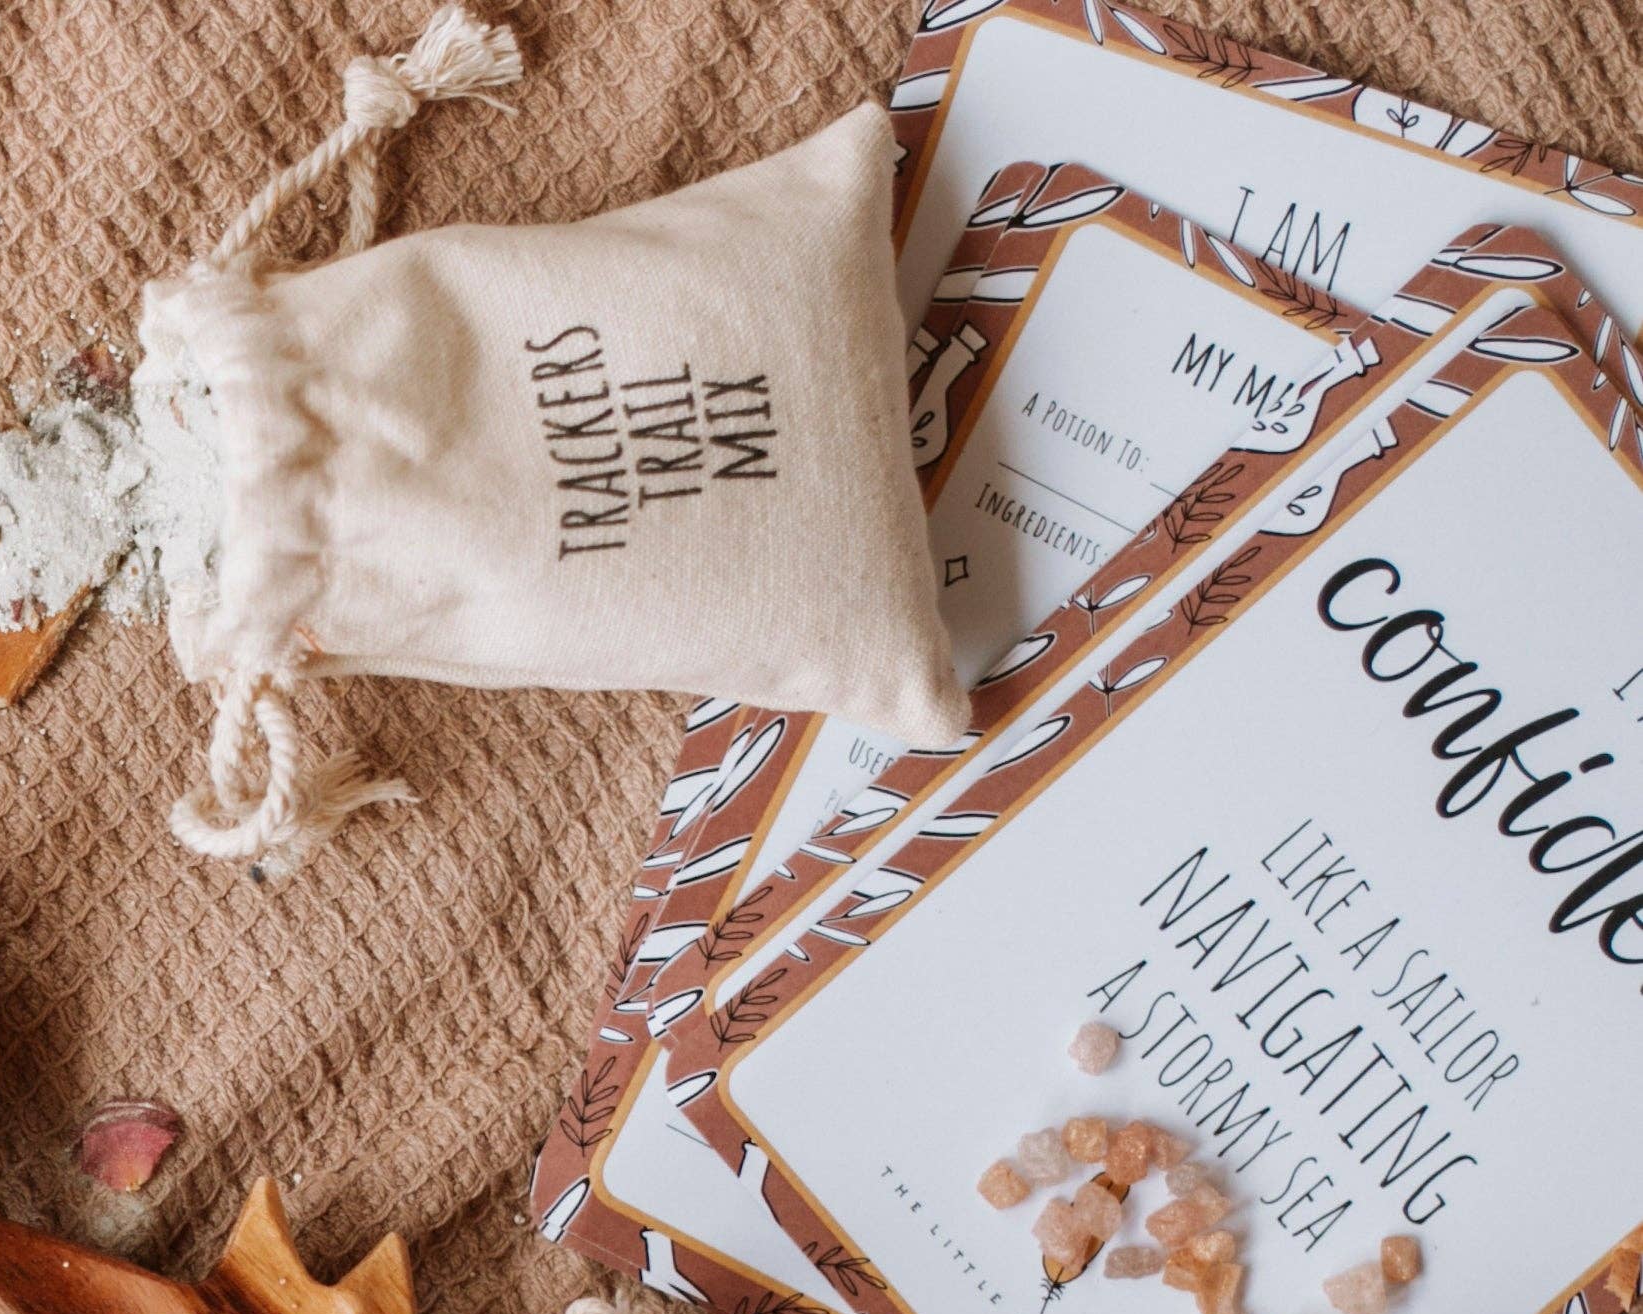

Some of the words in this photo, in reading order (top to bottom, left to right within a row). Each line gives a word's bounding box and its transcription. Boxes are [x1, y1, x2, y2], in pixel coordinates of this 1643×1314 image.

[1229, 186, 1255, 243] I
[1261, 202, 1351, 291] AM
[702, 373, 777, 479] MIX
[1021, 391, 1039, 418] A
[1040, 399, 1115, 456] POTION
[1116, 438, 1151, 474] TO:
[1171, 332, 1235, 392] MY
[524, 325, 630, 561] TRACKERS
[620, 361, 704, 509] TRAIL
[974, 482, 1110, 568] INGREDIENTS:
[1317, 557, 1643, 1002] confide
[1138, 846, 1479, 1226] NAVIGATING
[1261, 818, 1371, 934] LIKE
[1339, 917, 1401, 971] A
[1371, 948, 1520, 1112] SAILOR
[1086, 959, 1148, 1014] A
[1117, 990, 1293, 1174] STORMY
[1259, 1156, 1354, 1253] SEA
[880, 1165, 922, 1214] THE
[929, 1223, 1003, 1306] LITTLE
